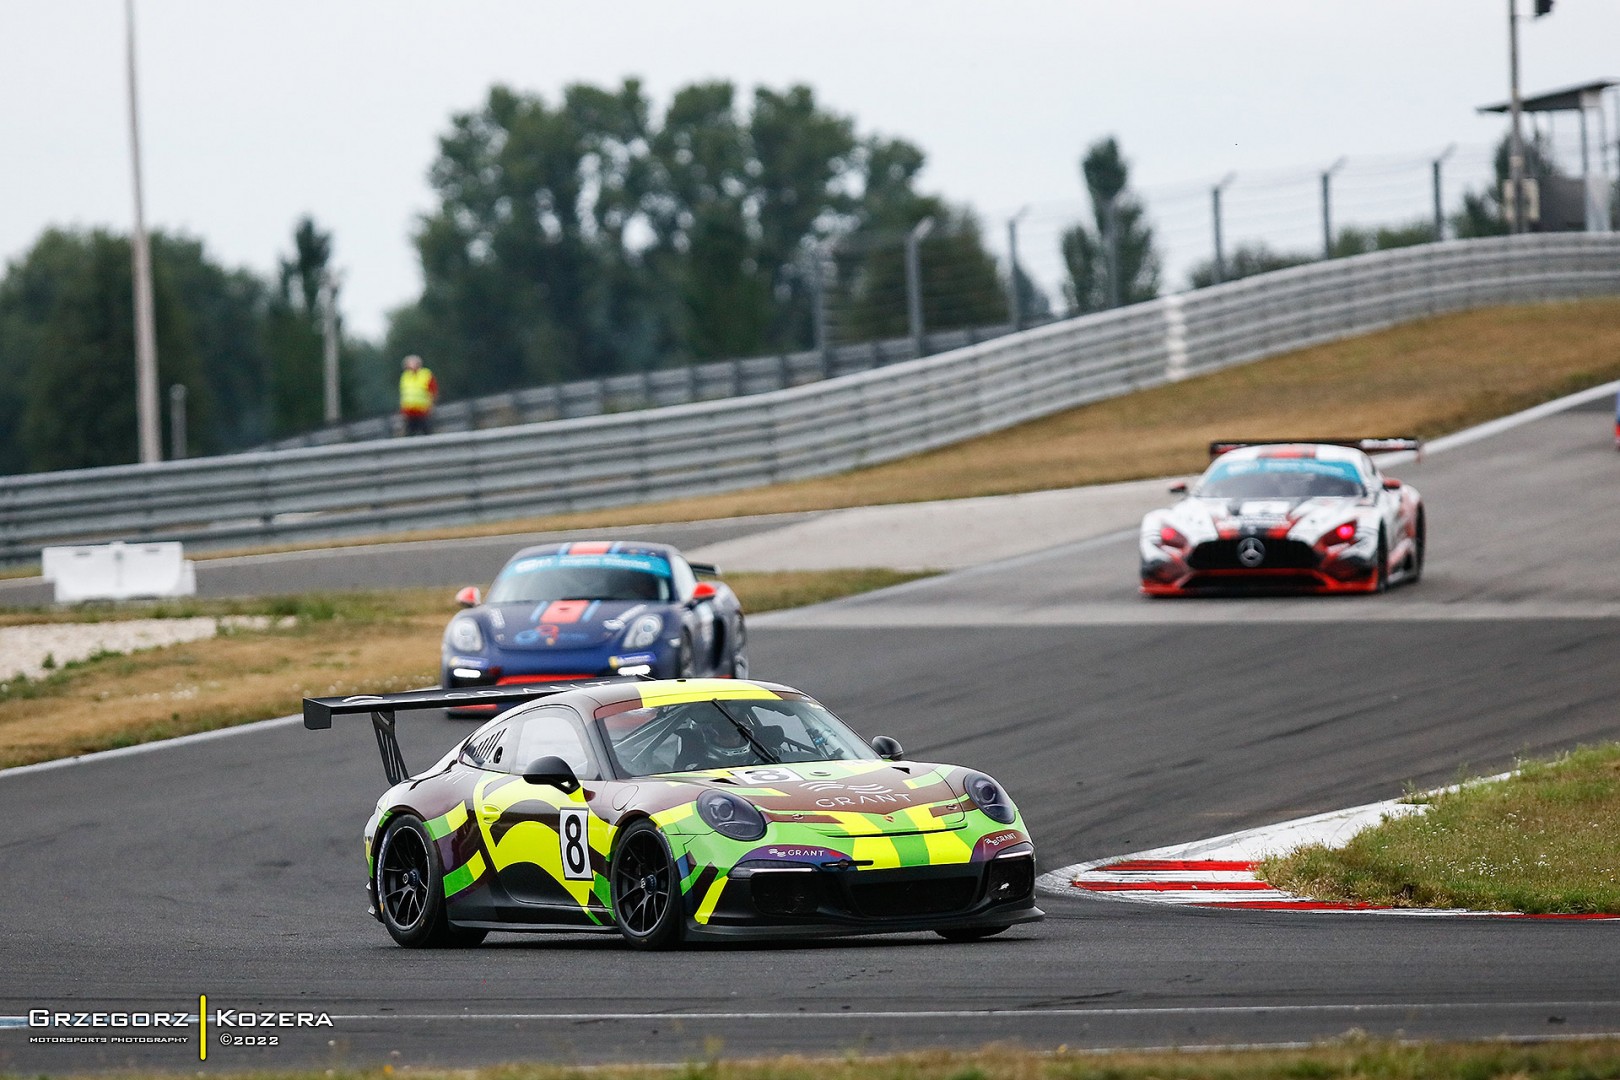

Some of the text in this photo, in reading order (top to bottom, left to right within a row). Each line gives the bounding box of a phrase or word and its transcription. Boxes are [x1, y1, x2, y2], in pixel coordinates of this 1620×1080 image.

[744, 769, 790, 782] 8
[815, 793, 912, 808] GRANT
[564, 813, 586, 875] 8
[787, 849, 825, 857] GRANT
